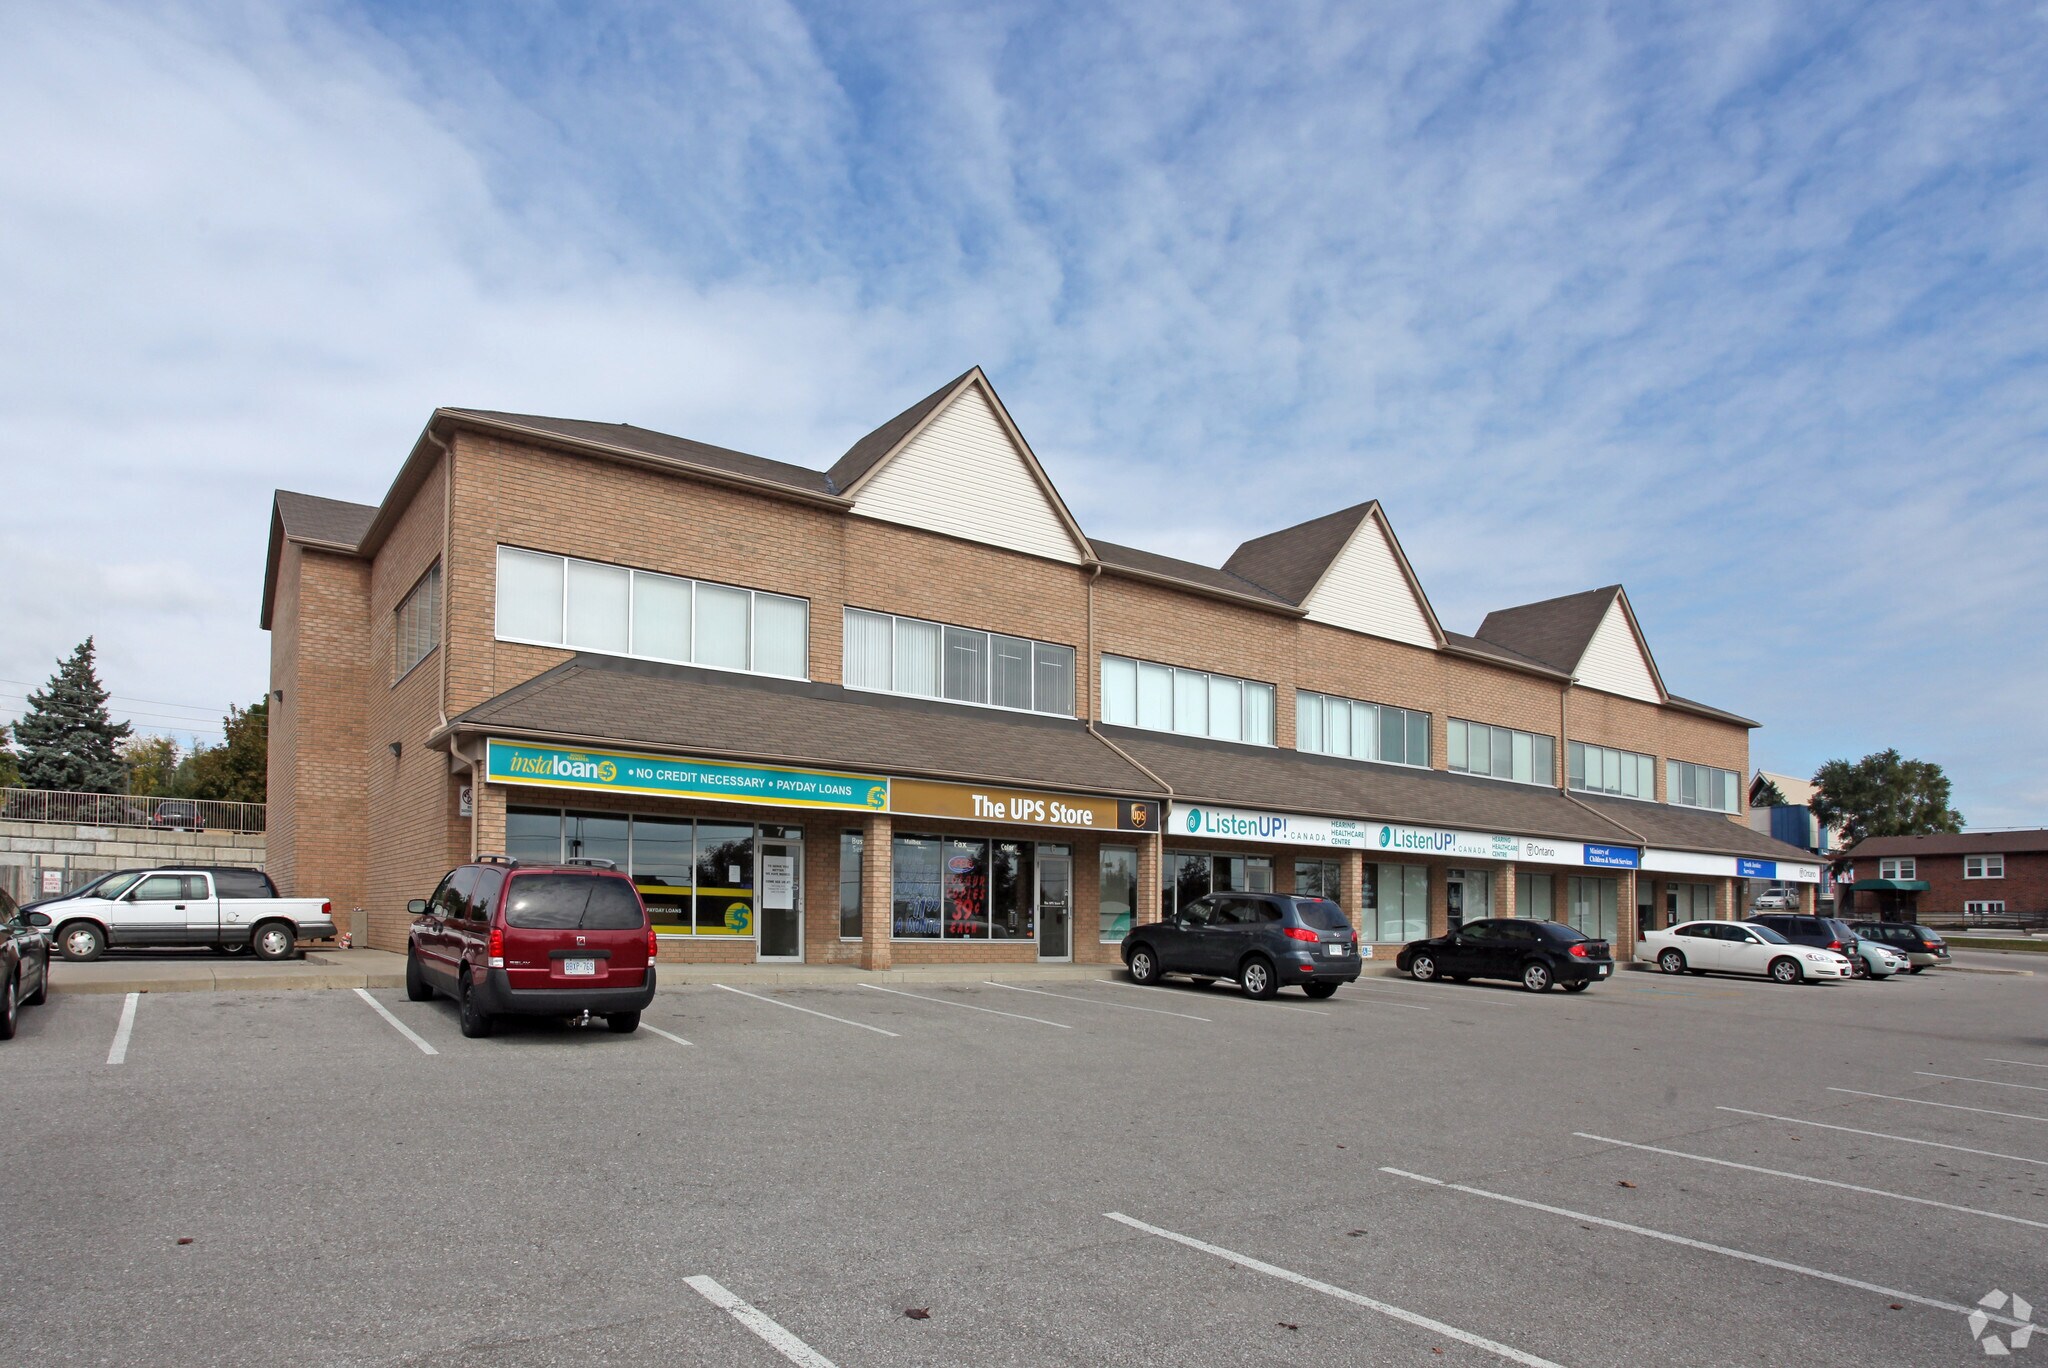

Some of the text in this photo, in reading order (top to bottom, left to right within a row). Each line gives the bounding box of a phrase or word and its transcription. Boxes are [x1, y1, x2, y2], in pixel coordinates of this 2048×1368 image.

[636, 768, 852, 796] NO CREDIT NECESSARY PAYDAY LOANS
[971, 794, 1093, 825] The UPS Store
[1131, 810, 1146, 824] ups
[1205, 811, 1326, 841] ListenUP! CANADA
[1331, 820, 1356, 829] HEARING
[777, 826, 784, 837] 7
[1331, 829, 1364, 839] HEALTHCARE
[953, 839, 967, 849] Fax
[1331, 838, 1351, 846] CENTRE
[1393, 828, 1486, 854] ListenUP! CANADA
[1534, 845, 1555, 857] Ontario
[1589, 848, 1610, 856] Ministry of
[1589, 855, 1605, 863] Children
[1803, 869, 1816, 878] Ontario
[946, 887, 986, 900] COPIES
[950, 921, 977, 934] EACH
